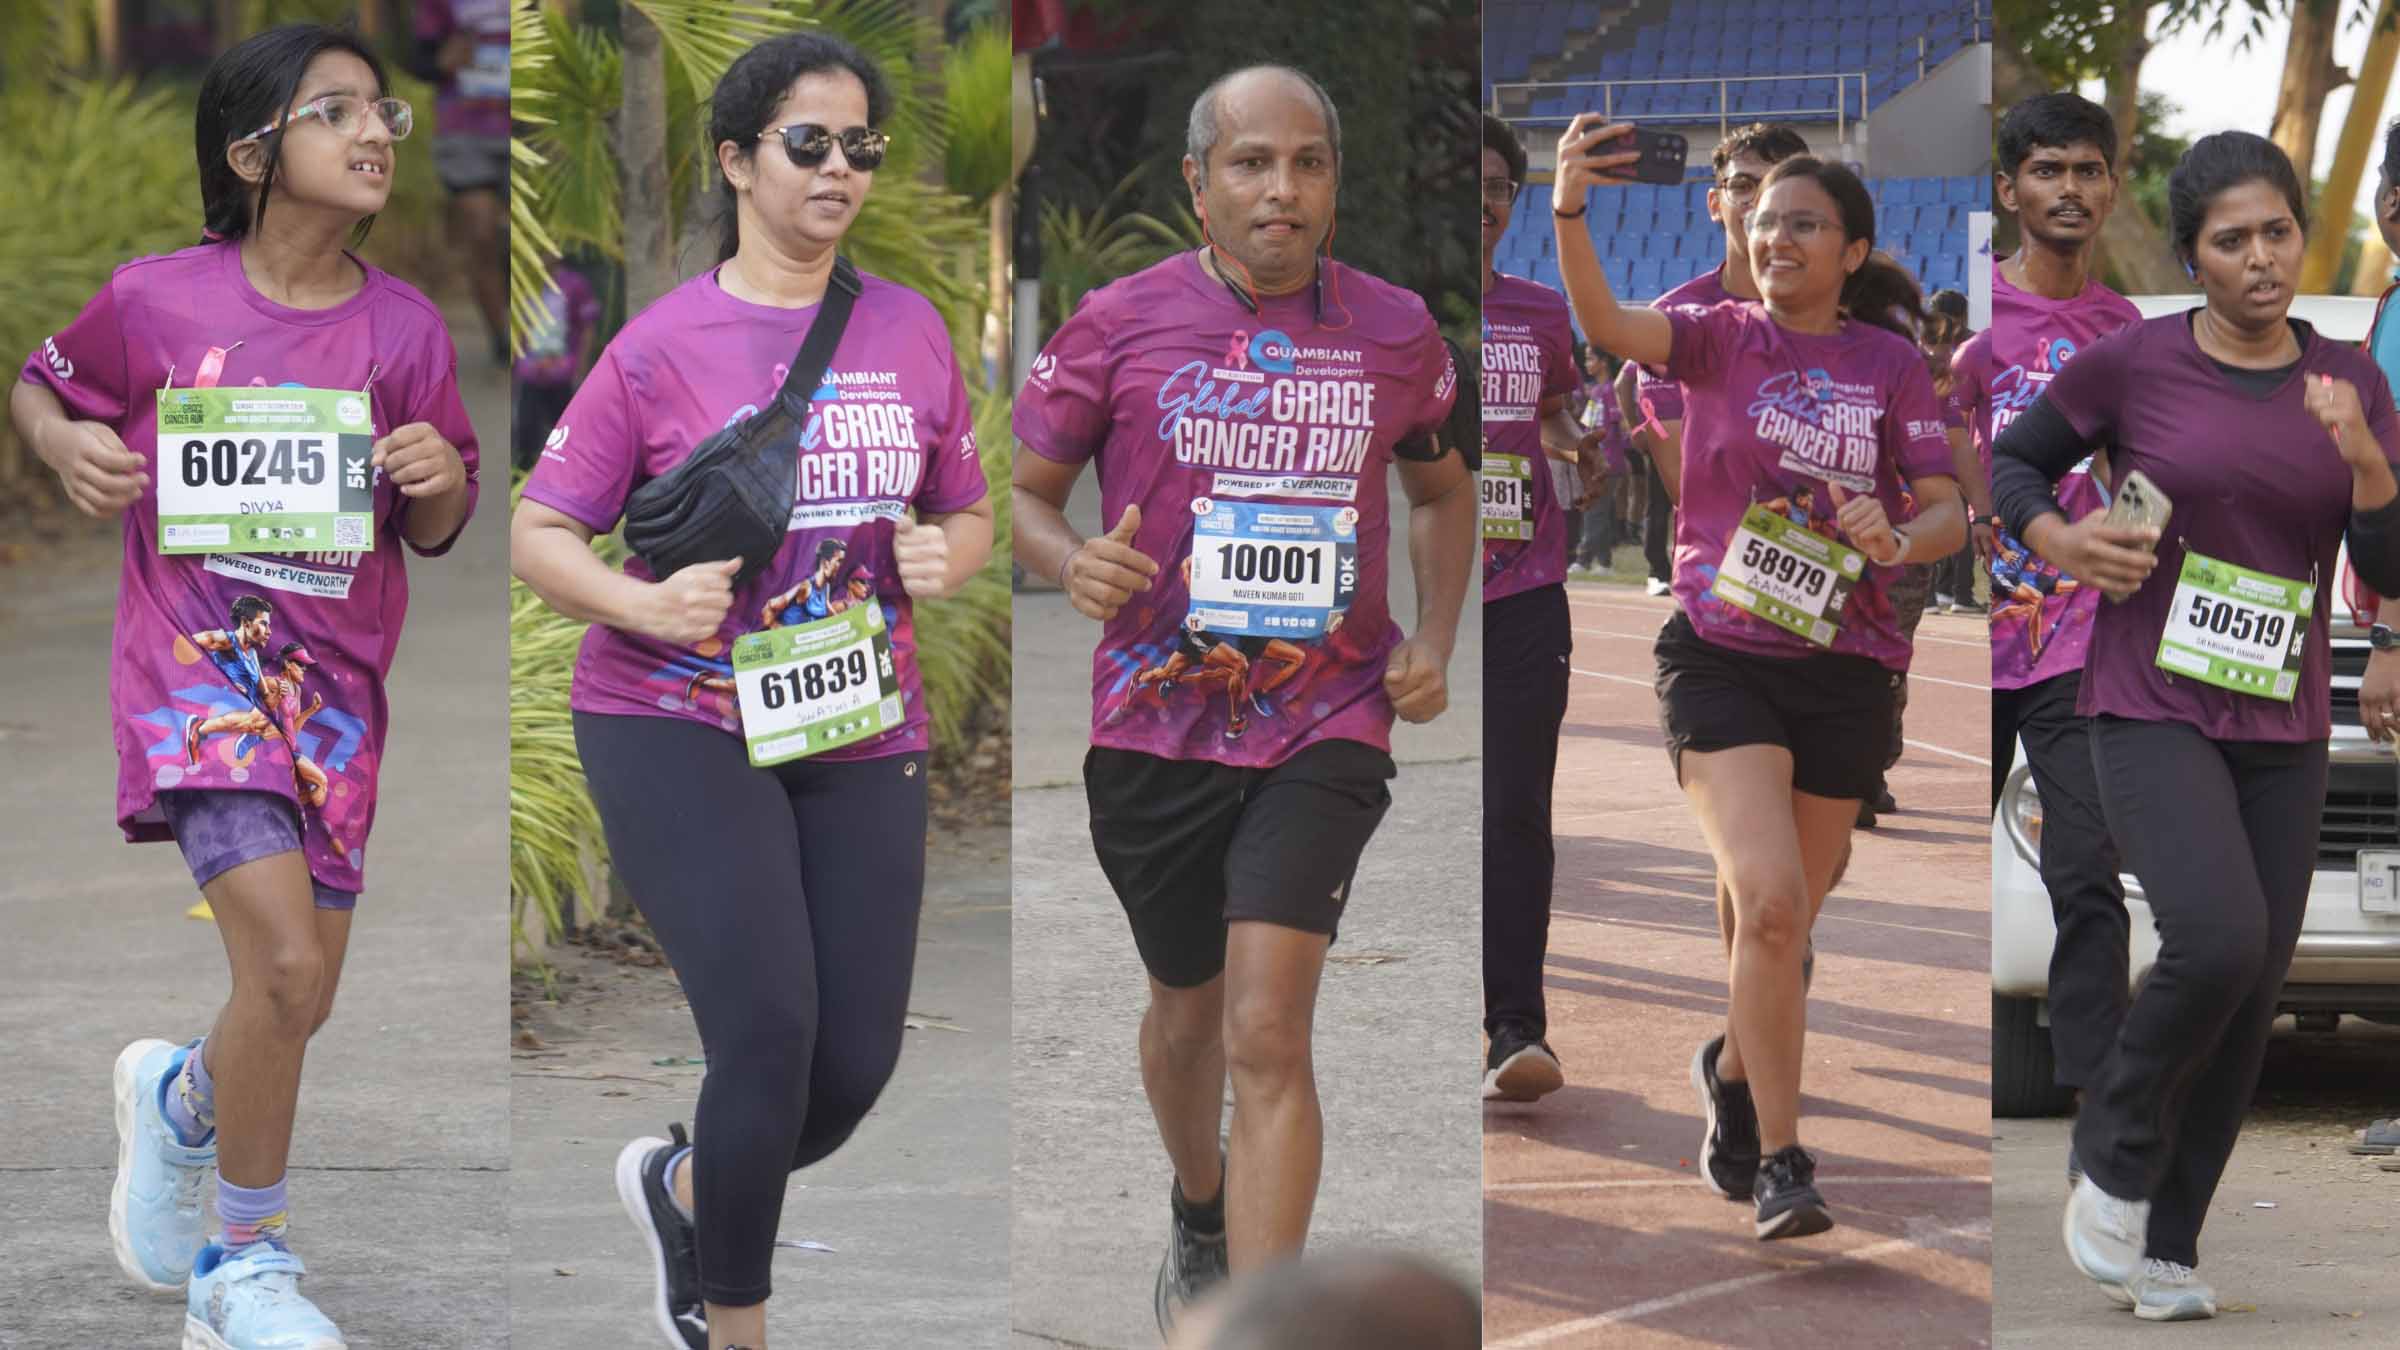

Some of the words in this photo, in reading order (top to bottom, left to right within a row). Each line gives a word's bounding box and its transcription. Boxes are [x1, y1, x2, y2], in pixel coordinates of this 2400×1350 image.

[1266, 345, 1362, 362] QUAMBIANT
[1295, 365, 1364, 377] Developers
[840, 389, 902, 400] Developers
[1157, 361, 1270, 441] Global
[1273, 379, 1376, 427] GRACE
[822, 403, 920, 450] GRACE
[1756, 406, 1839, 468] CANCER
[1174, 417, 1299, 472] CANCER
[1304, 427, 1373, 473] RUN
[182, 439, 325, 487] 60245
[346, 457, 366, 489] 5K
[866, 450, 921, 497] RUN
[1217, 479, 1263, 489] POWERED
[240, 500, 284, 514] DIVYA
[209, 552, 262, 573] POWERED
[1217, 544, 1321, 584] 10001
[1340, 557, 1355, 594] 10K
[1742, 538, 1827, 597] 58979
[1233, 589, 1261, 599] NAVEEN
[1829, 589, 1848, 611] 5K
[2189, 594, 2285, 648] 50519
[2291, 631, 2305, 656] 5K
[761, 648, 869, 710] 61839
[878, 649, 895, 678] 5K
